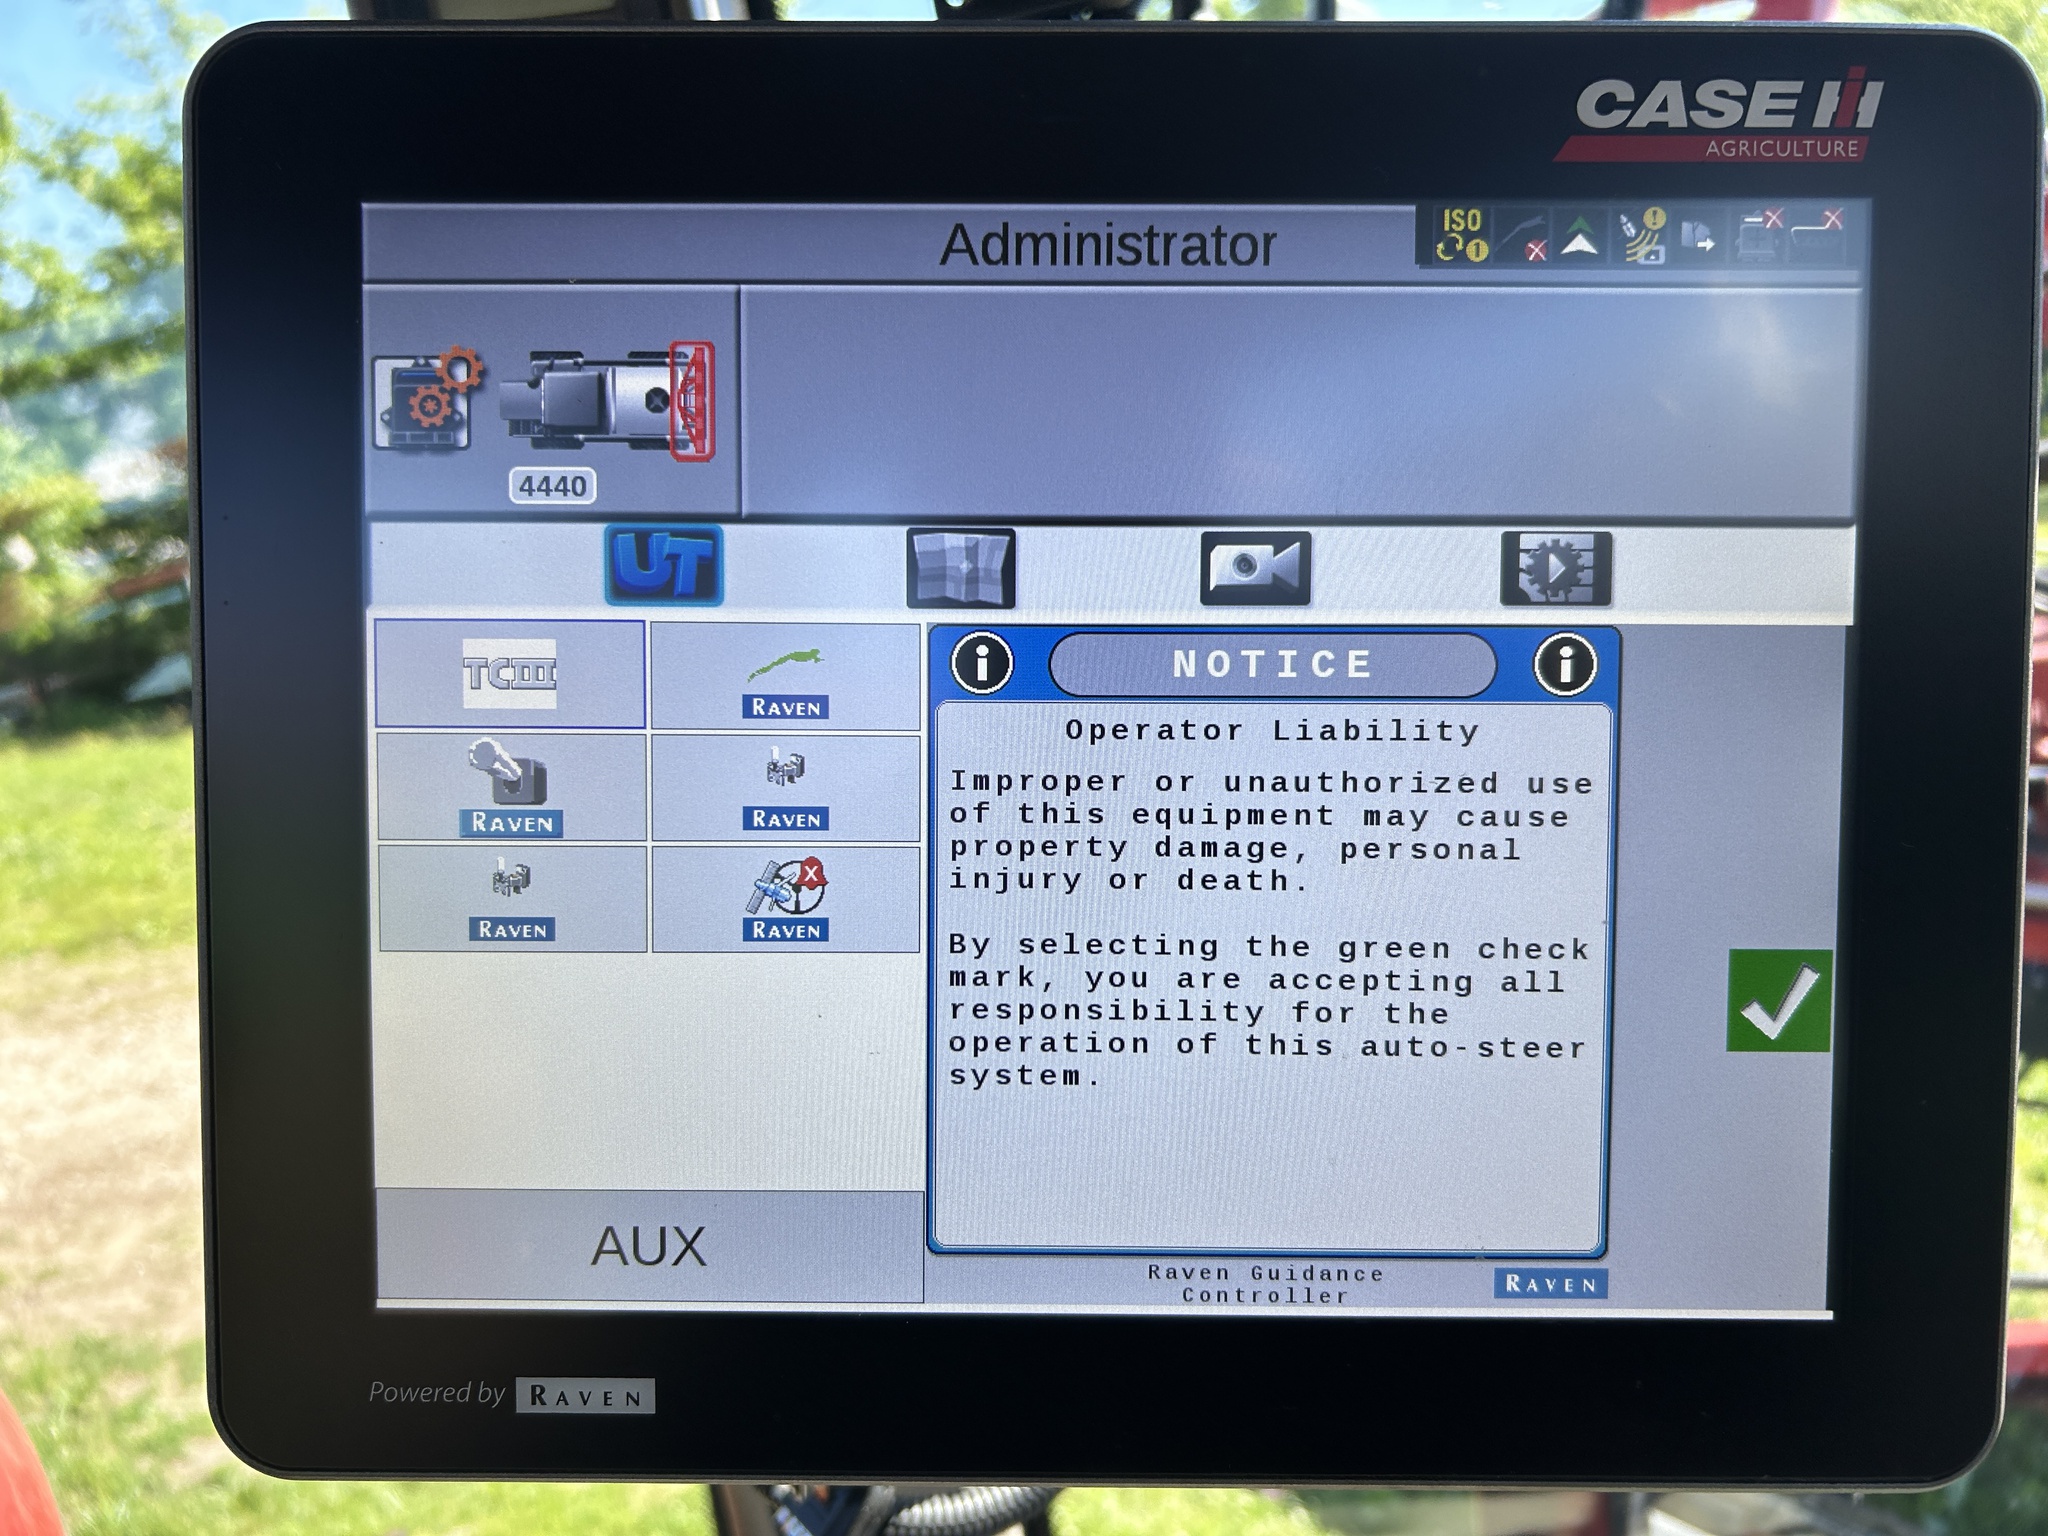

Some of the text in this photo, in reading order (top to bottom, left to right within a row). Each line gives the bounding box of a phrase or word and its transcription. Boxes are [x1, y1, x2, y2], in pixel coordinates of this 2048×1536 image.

[1576, 79, 1804, 129] CASE
[1706, 138, 1859, 158] AGRICULTURE
[1443, 209, 1482, 231] ISO
[941, 220, 1278, 268] Administrator
[519, 475, 587, 497] 4440
[612, 532, 714, 596] UT
[463, 657, 557, 690] TCIII
[1172, 649, 1373, 679] NOTICE
[752, 697, 821, 716] RAVEN
[1065, 718, 1480, 747] Operator Liability
[950, 769, 1594, 796] Improper or unauthorized use
[472, 812, 554, 833] RAVEN
[752, 809, 821, 828] RAVEN
[950, 802, 1570, 832] of this equipment may cause
[950, 836, 1521, 865] property damage, personal
[950, 867, 1308, 894] injury or death.
[479, 920, 547, 939] RAVEN
[752, 921, 821, 939] RAVEN
[949, 933, 1590, 963] By selecting the green check
[949, 967, 1565, 997] mark, you are accepting all
[950, 999, 1449, 1026] responsibility for the
[949, 1033, 1587, 1059] operation of this auto-steer
[949, 1066, 1100, 1090] system.
[590, 1225, 707, 1267] AUX
[1148, 1264, 1384, 1282] Raven Guidance
[1506, 1273, 1596, 1293] RAVEN
[1182, 1286, 1349, 1304] Controller
[369, 1381, 506, 1408] Powered by
